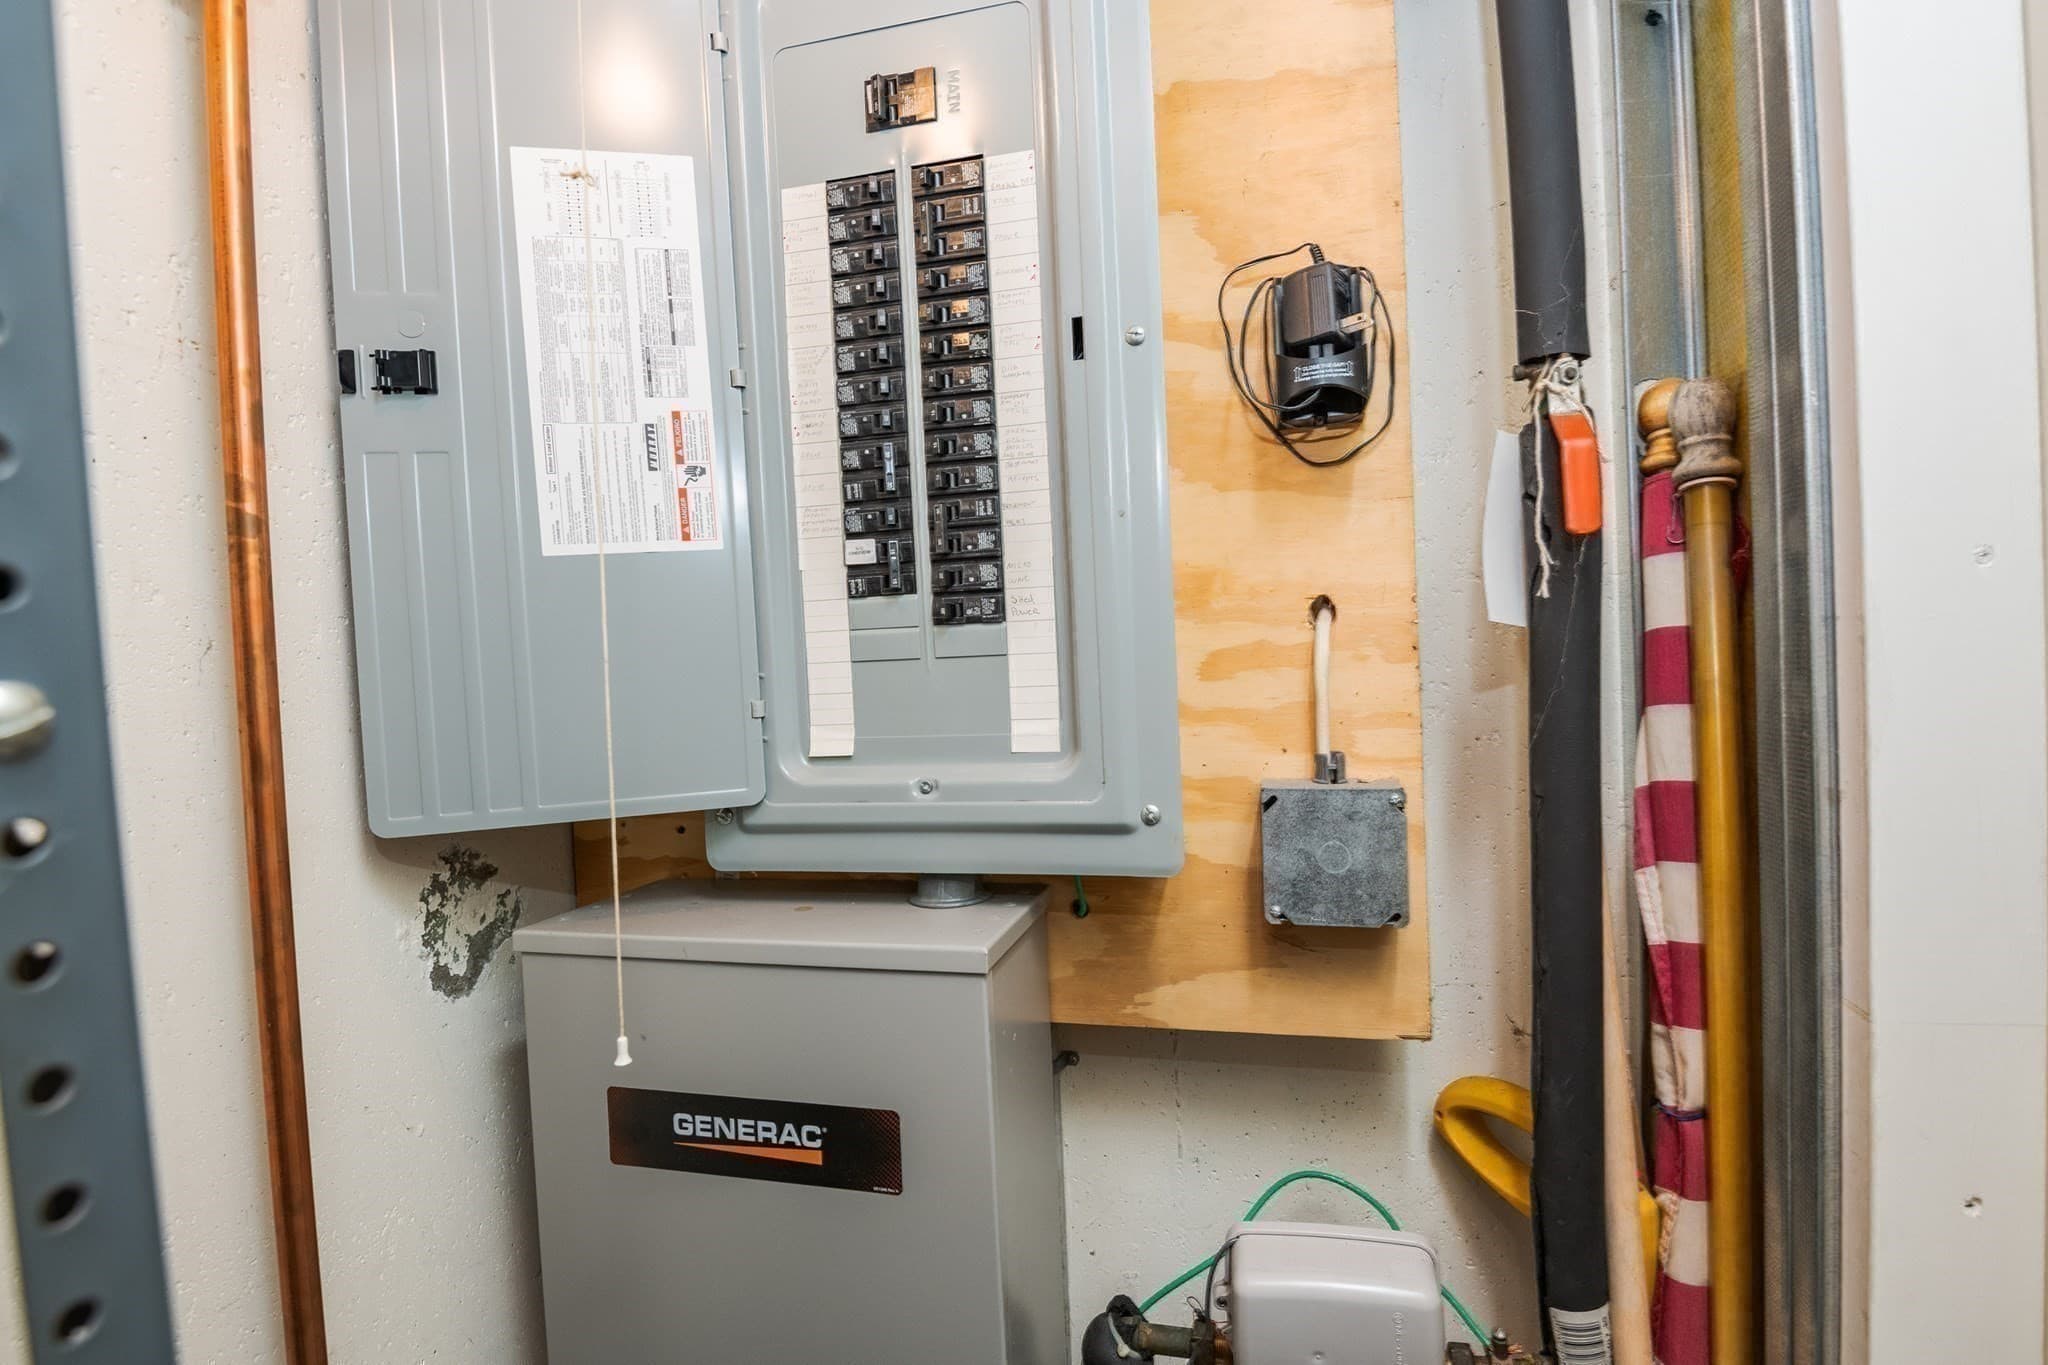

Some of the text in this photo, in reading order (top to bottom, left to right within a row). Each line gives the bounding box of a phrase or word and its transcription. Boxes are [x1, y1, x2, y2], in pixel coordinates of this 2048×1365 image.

[947, 69, 961, 113] MAIN
[679, 496, 689, 526] DANGER
[672, 1112, 824, 1148] GENERAC
